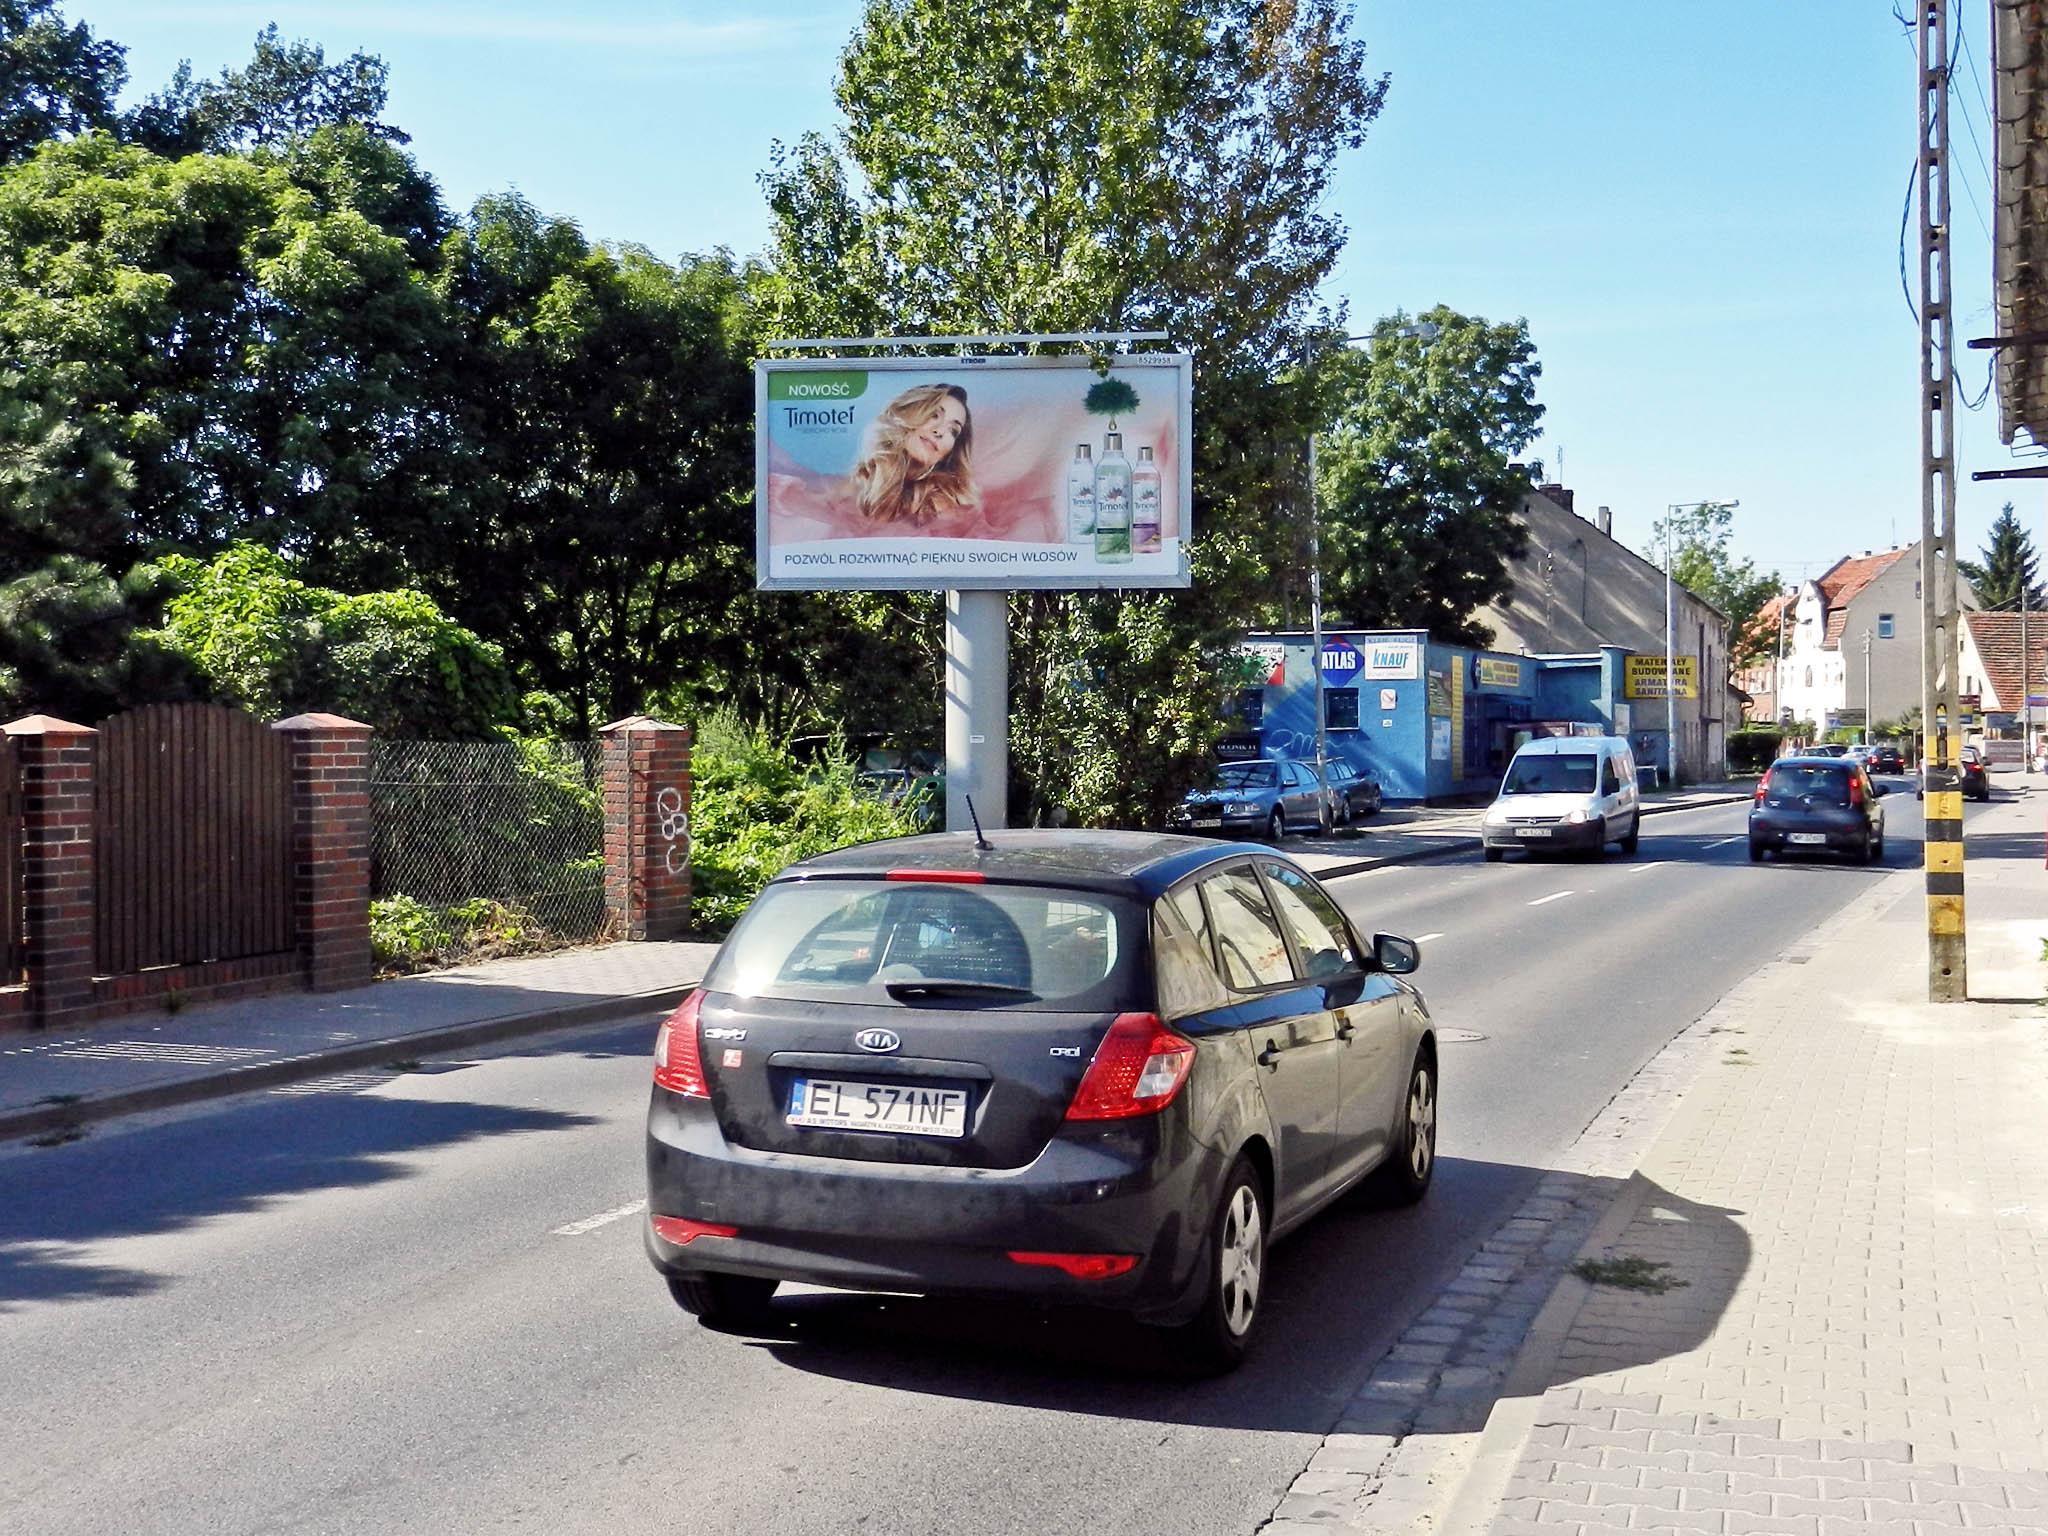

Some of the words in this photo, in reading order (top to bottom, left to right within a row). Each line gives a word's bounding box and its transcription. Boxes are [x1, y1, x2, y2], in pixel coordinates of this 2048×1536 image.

[788, 381, 850, 396] NOWOŚĆ
[783, 405, 855, 428] Timotei
[784, 553, 835, 565] POZWÓL
[839, 552, 918, 565] ROZKWITNĄĆ
[921, 552, 965, 565] PIĘKNU
[968, 552, 1018, 563] SWOICH
[1021, 550, 1078, 562] WŁOSÓW
[1321, 651, 1356, 670] ATLAS
[1373, 649, 1409, 669] KNAUF
[1635, 658, 1687, 666] MATERAŁY
[1631, 667, 1691, 676] BUDOWANE
[863, 1032, 893, 1049] KIA
[810, 1083, 850, 1118] EL
[864, 1087, 960, 1126] 571NF
